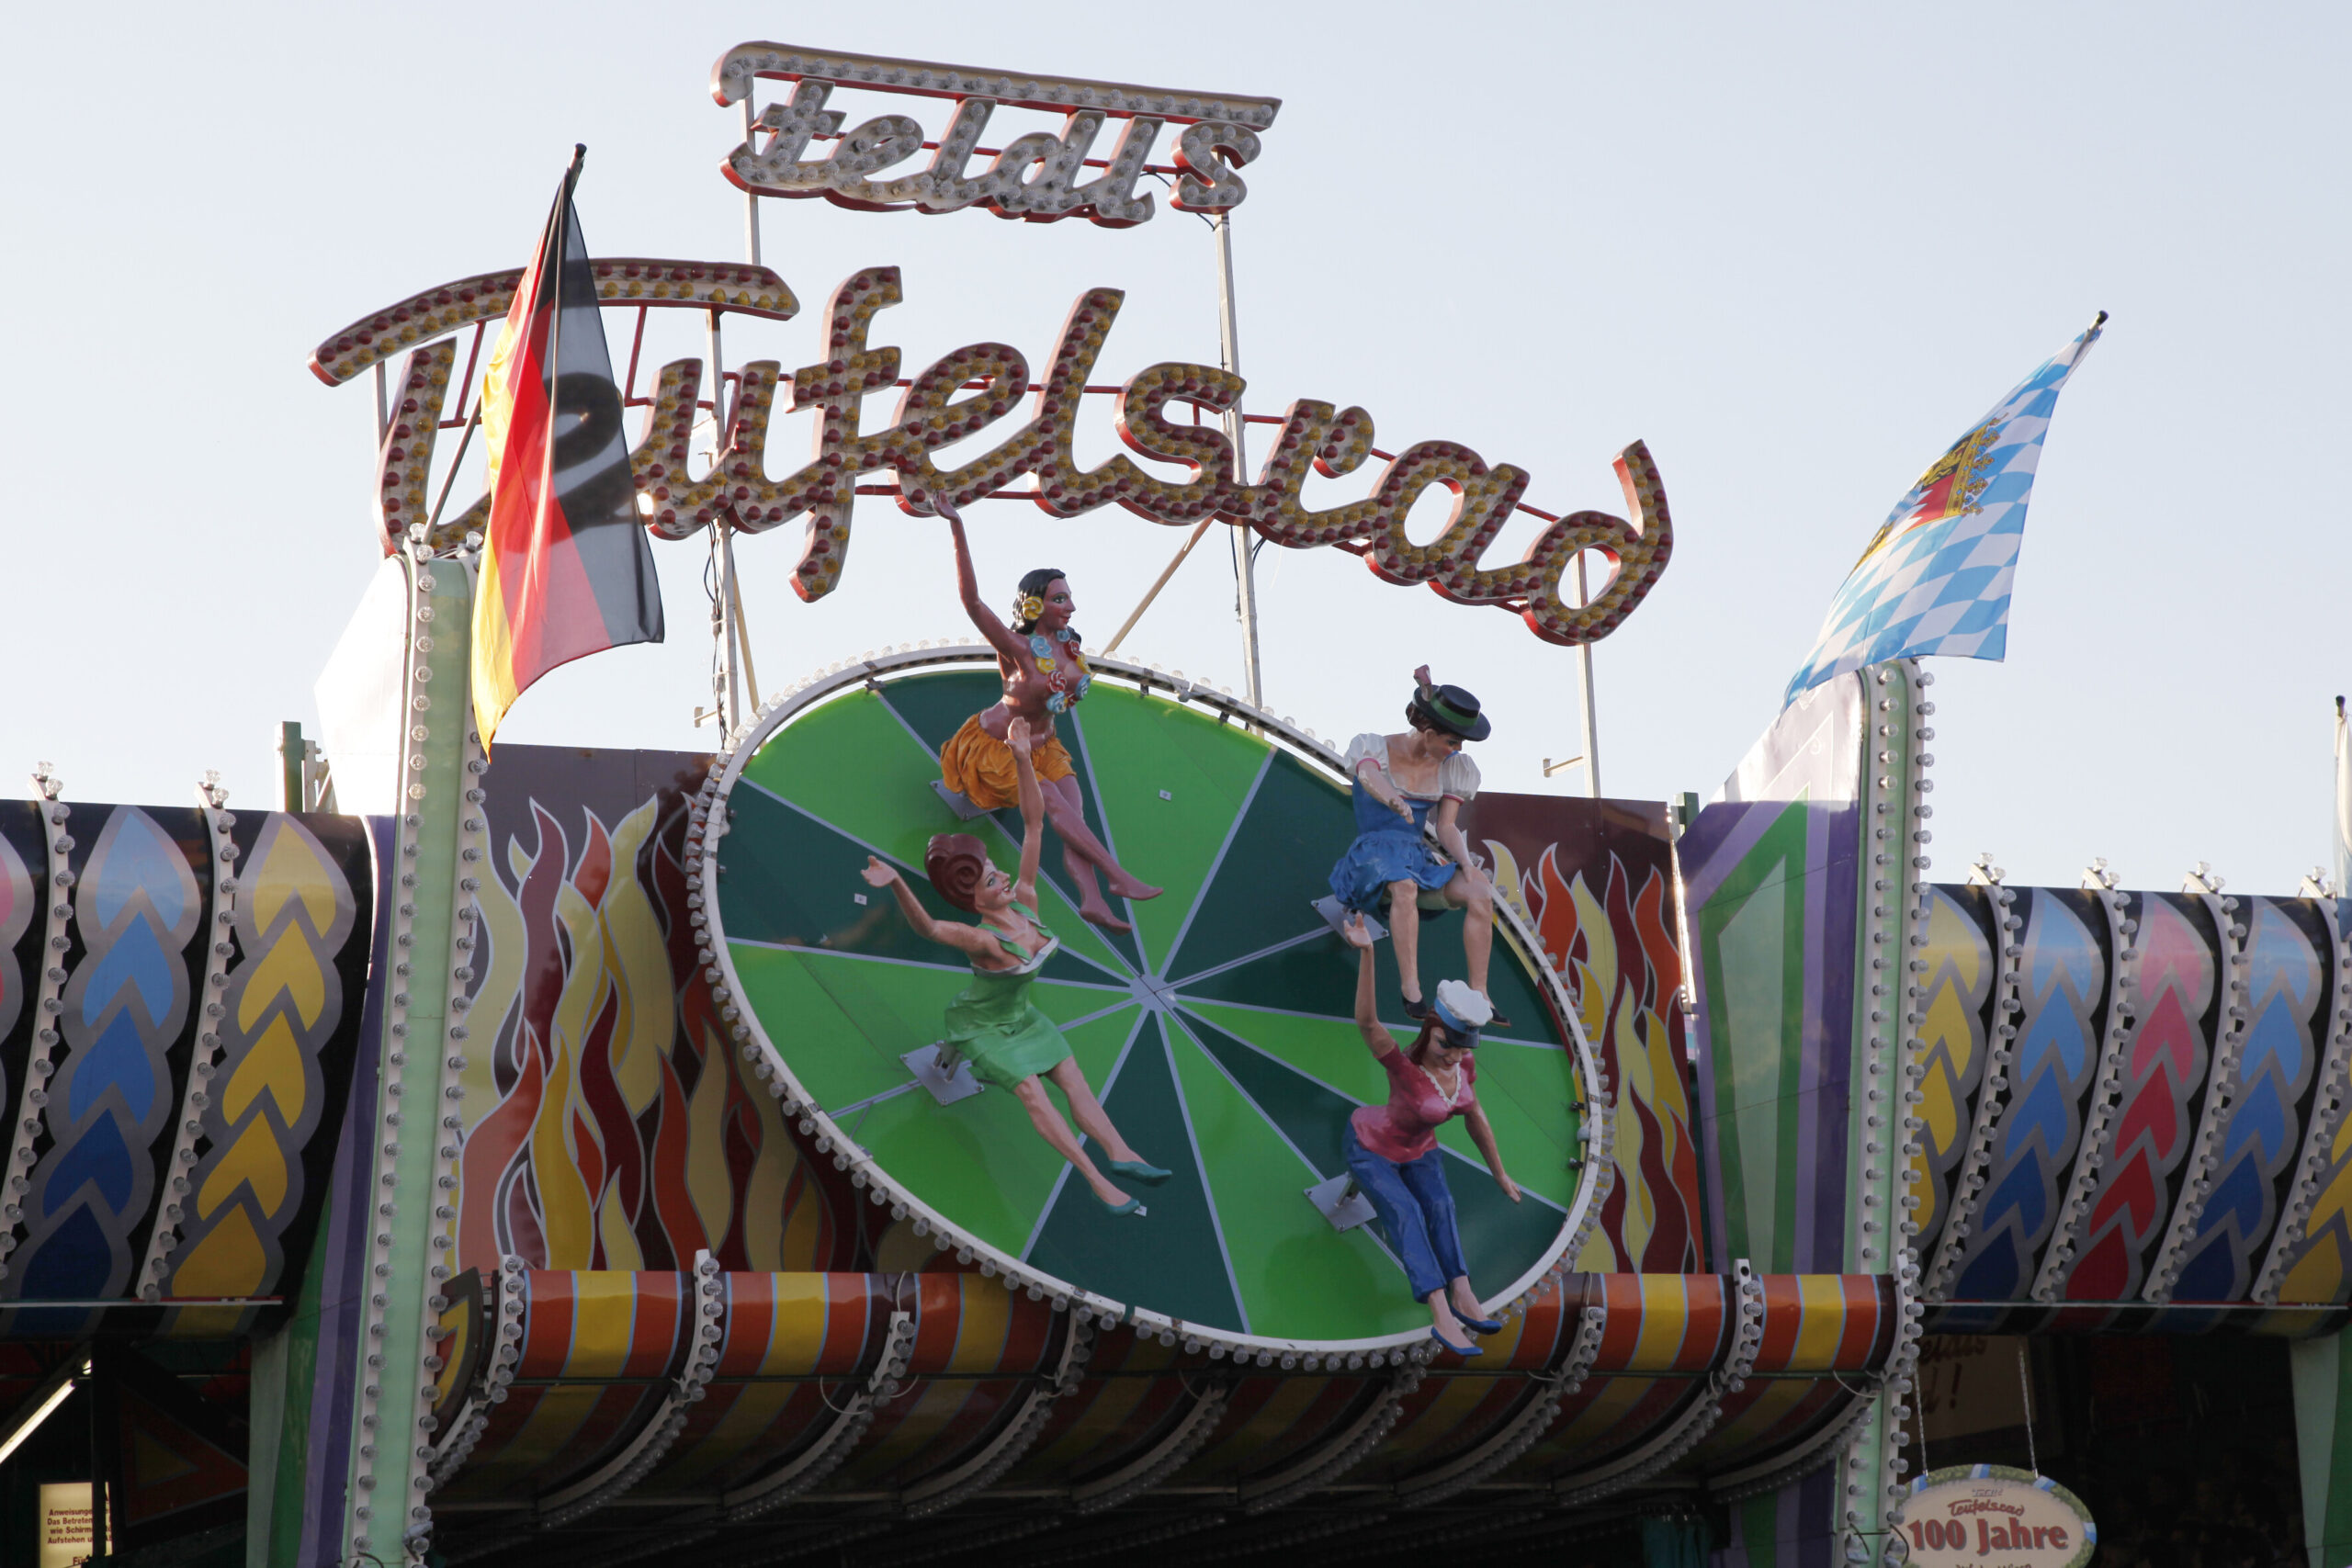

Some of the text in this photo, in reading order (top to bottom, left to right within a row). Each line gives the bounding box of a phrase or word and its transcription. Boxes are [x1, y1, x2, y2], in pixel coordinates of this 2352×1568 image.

[306, 257, 1674, 647] Teufelsrad
[49, 1508, 93, 1517] Anweisunge
[1948, 1499, 2025, 1517] Teufelsrad
[47, 1517, 61, 1526] Das
[65, 1526, 93, 1534] Schirm
[1907, 1517, 2069, 1556] 100 Jahre
